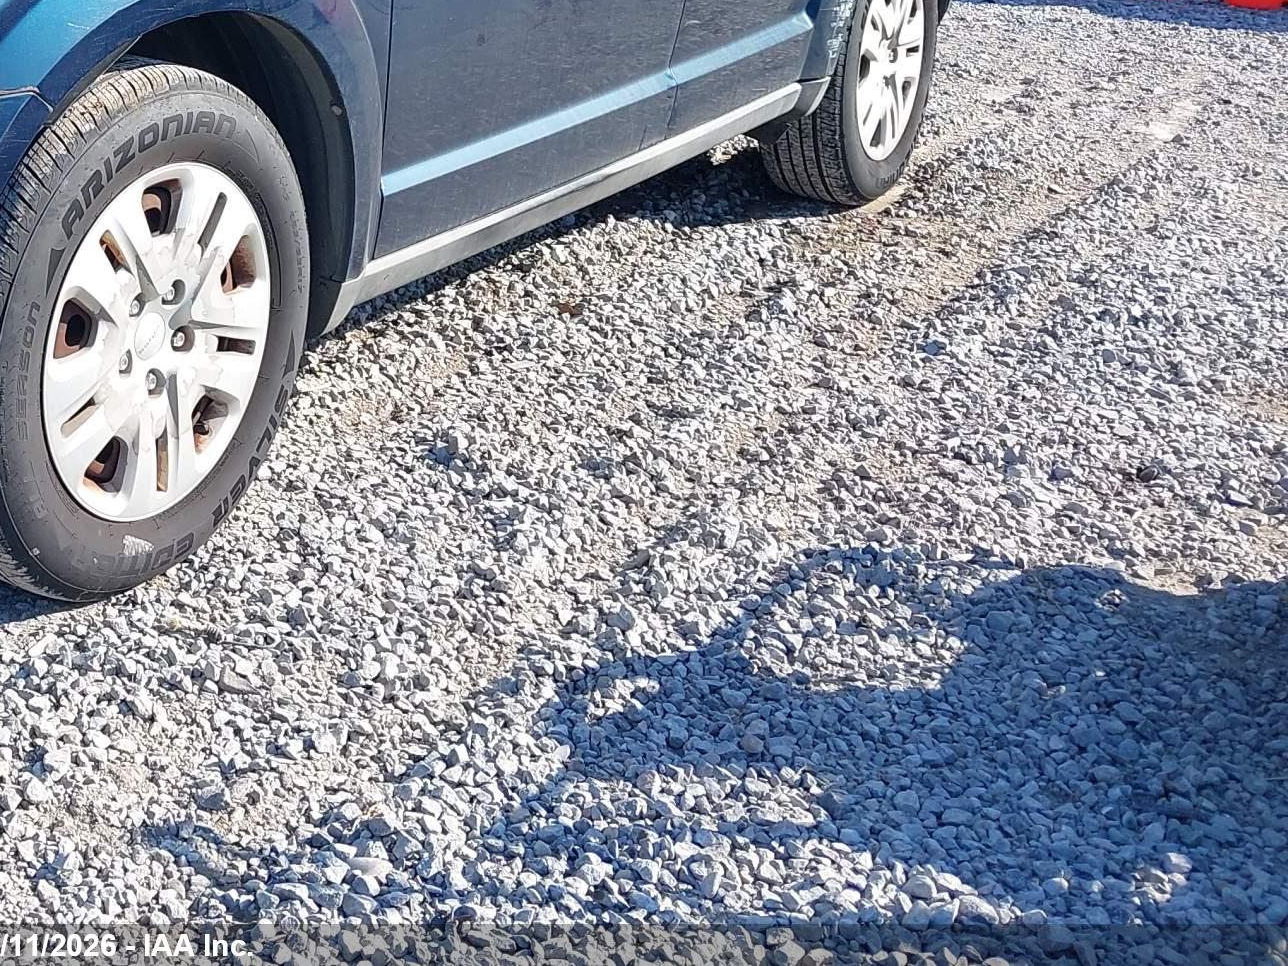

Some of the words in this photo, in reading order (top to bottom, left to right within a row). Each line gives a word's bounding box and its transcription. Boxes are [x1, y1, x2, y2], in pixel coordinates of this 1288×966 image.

[61, 110, 237, 241] ARIZONIAN
[16, 300, 42, 443] SEASON
[211, 384, 289, 529] SILVER
